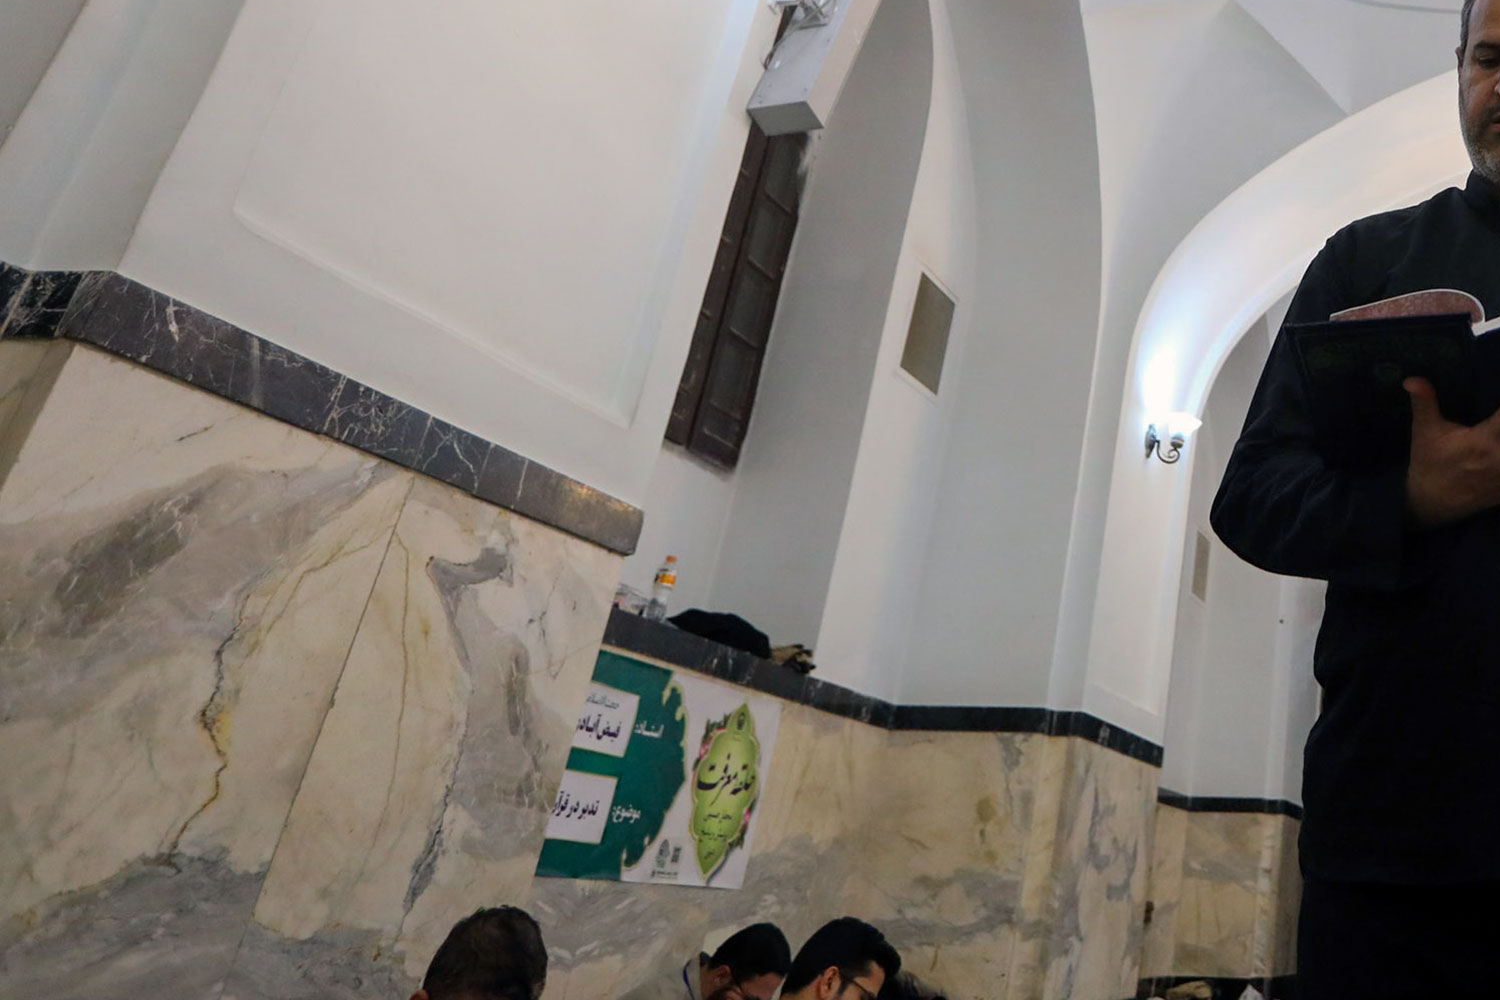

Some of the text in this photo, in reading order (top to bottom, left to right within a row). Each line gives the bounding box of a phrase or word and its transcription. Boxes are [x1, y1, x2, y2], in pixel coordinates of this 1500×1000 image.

[566, 800, 580, 819] در
[577, 799, 600, 820] تدبر
[611, 804, 641, 824] موضوع:
